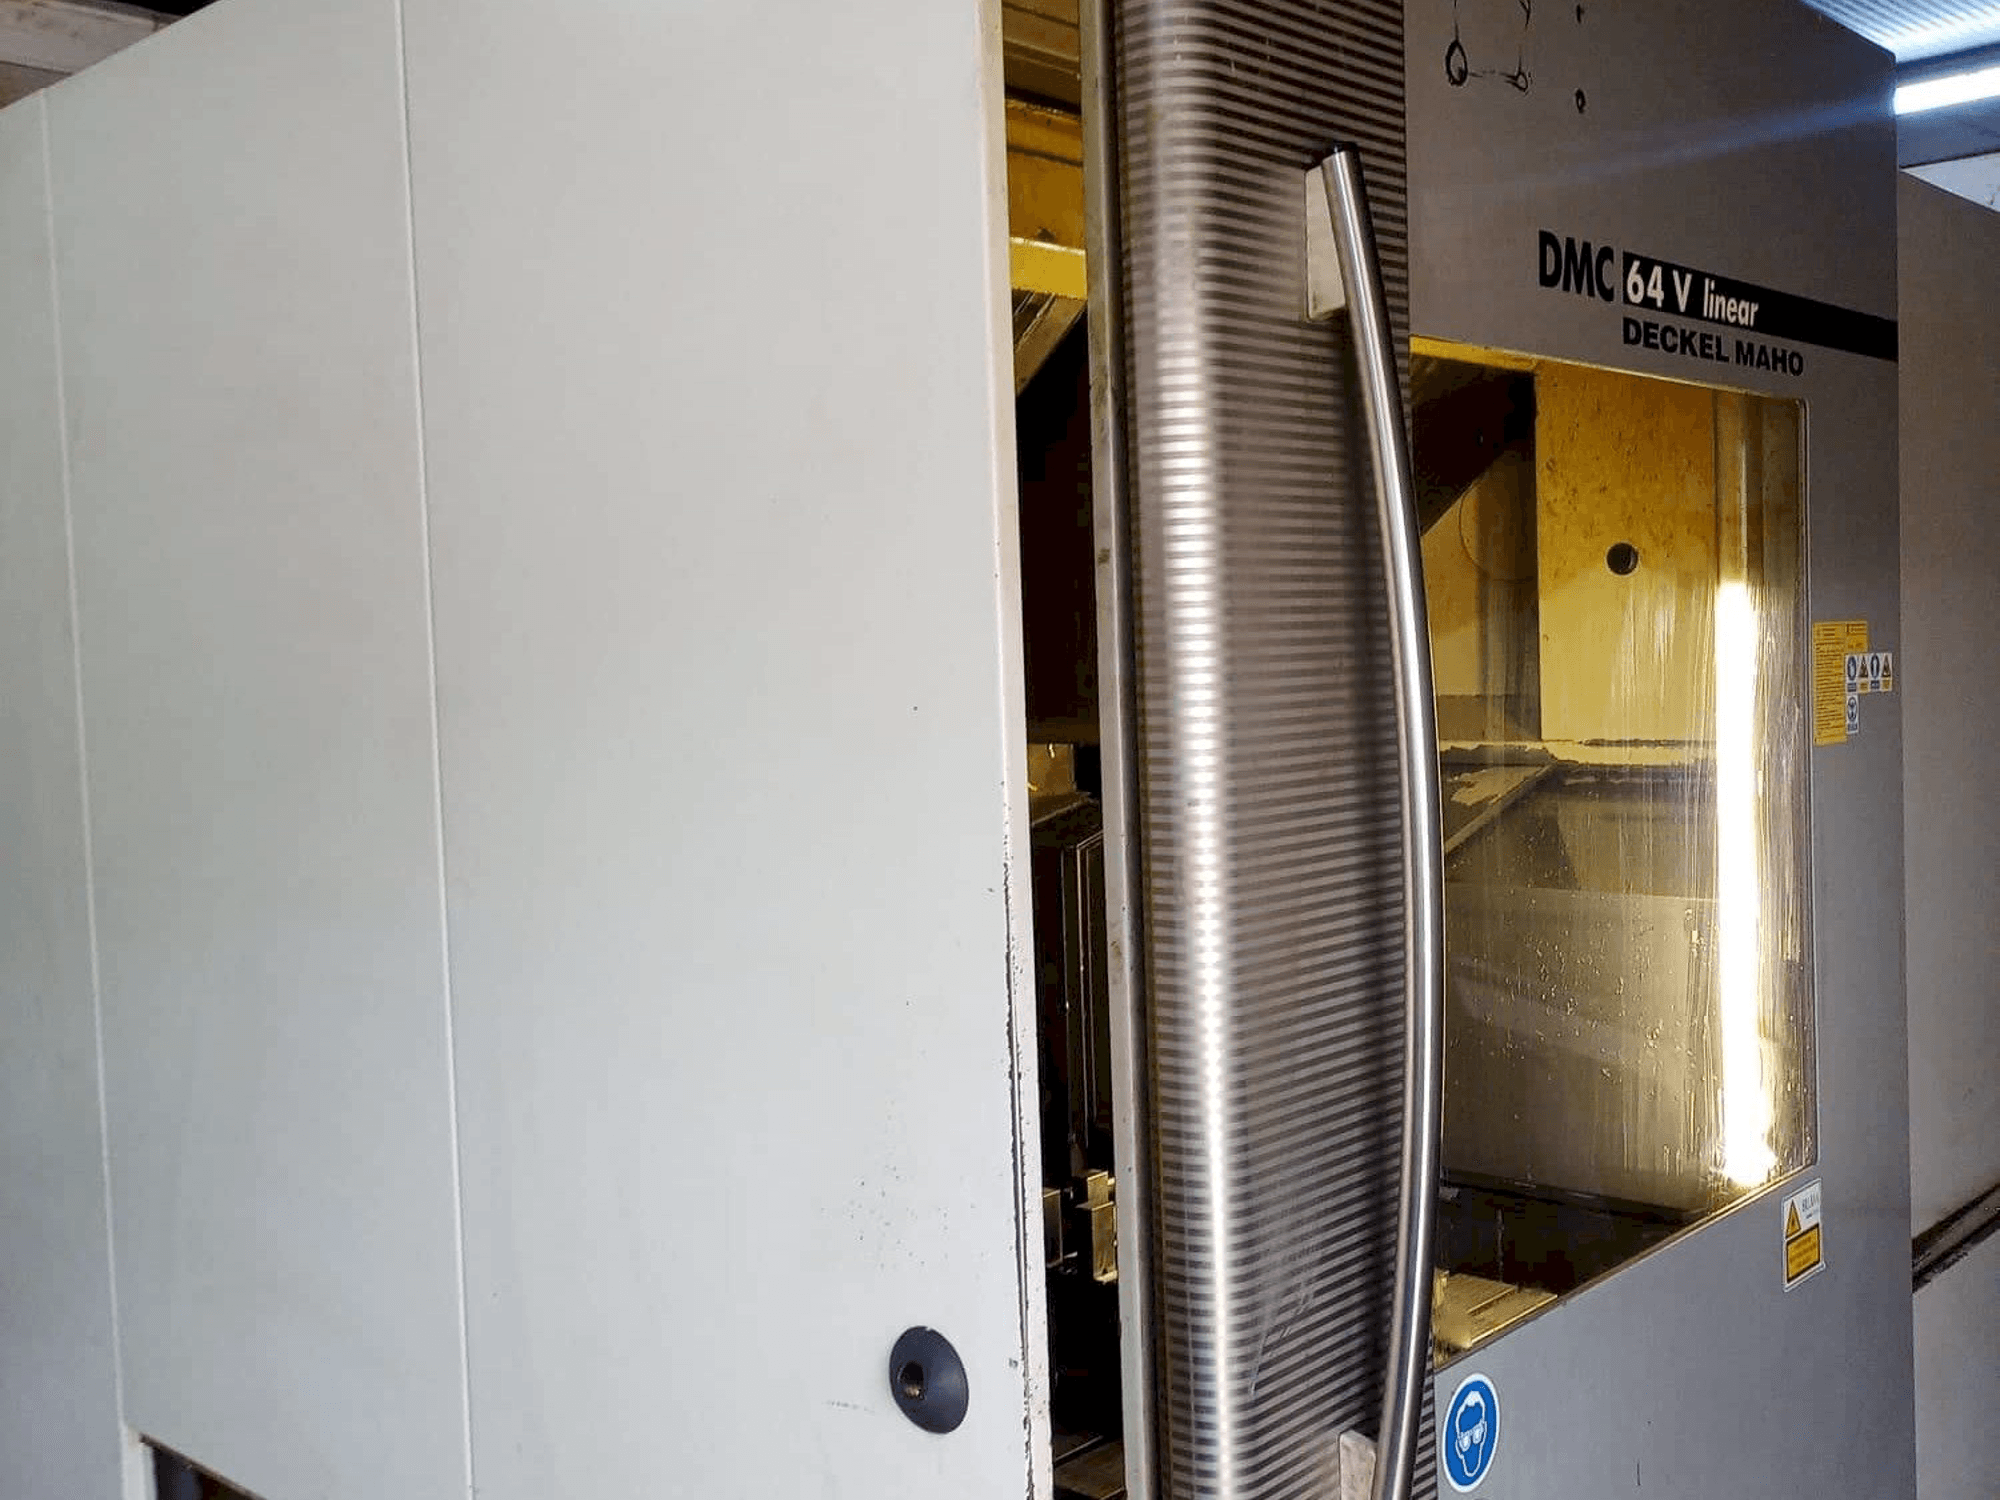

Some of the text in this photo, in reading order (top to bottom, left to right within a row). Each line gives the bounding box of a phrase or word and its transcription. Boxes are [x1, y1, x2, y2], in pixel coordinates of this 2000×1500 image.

[1539, 231, 1759, 327] DMC 64 V linear
[1623, 318, 1804, 377] DECKEL MAHO
